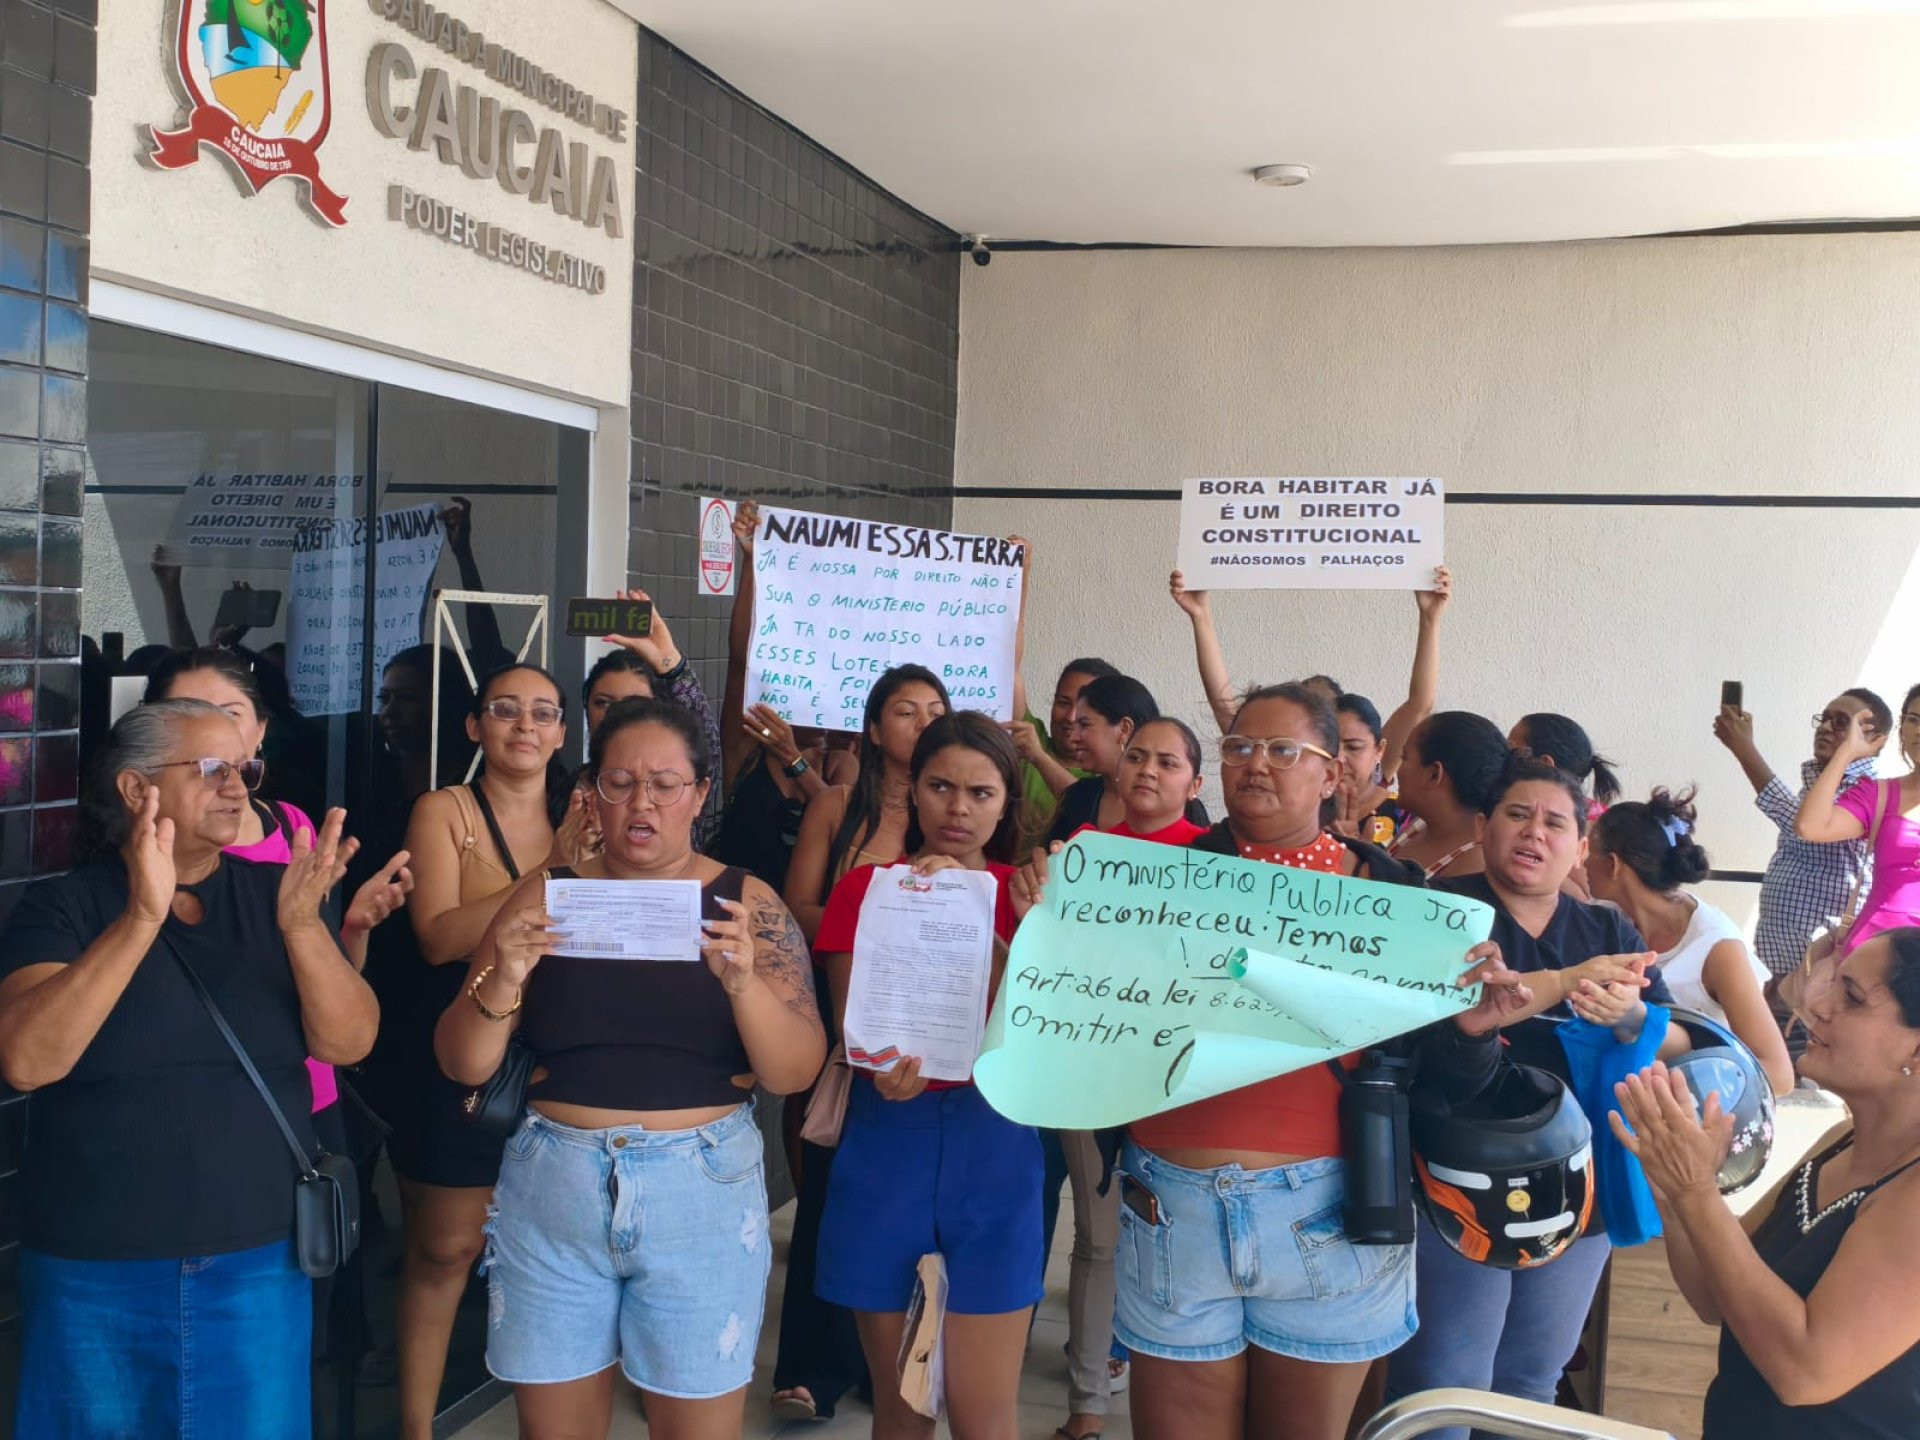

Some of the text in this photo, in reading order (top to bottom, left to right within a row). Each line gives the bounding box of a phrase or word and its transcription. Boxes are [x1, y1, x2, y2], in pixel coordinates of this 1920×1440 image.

[485, 43, 595, 127] MUNICIPAL
[594, 104, 628, 143] DE
[231, 125, 286, 159] CAUCAIA
[365, 42, 624, 239] CAUCAIA
[387, 184, 607, 295] PODER LEGISLATIVO
[1199, 478, 1437, 496] BORA HABITAR JÁ
[1220, 502, 1400, 520] É UM DIREITO
[763, 513, 862, 549] NAUMI
[1202, 529, 1421, 544] CONSTITUCIONAL
[788, 552, 799, 571] É
[810, 561, 857, 577] NOSSA
[873, 567, 899, 581] POR
[914, 572, 961, 584] DIREITO
[971, 574, 999, 588] NÃO
[1007, 573, 1018, 589] É
[1321, 554, 1405, 568] PALHAÇOS
[765, 584, 793, 605] SUA
[832, 594, 926, 613] MINISTERIO
[937, 598, 1008, 617] PÚBLICO
[574, 606, 617, 630] mil
[794, 620, 815, 637] TA
[828, 627, 851, 641] DO
[863, 630, 922, 645] NOSSO
[937, 633, 986, 648] LADO
[755, 642, 817, 666] ESSES
[943, 663, 989, 680] BORA
[760, 689, 789, 705] NÃO
[1063, 843, 1086, 884] O
[1116, 976, 1152, 1006] da
[1161, 978, 1199, 1006] lei
[1011, 1005, 1139, 1046] Omitir
